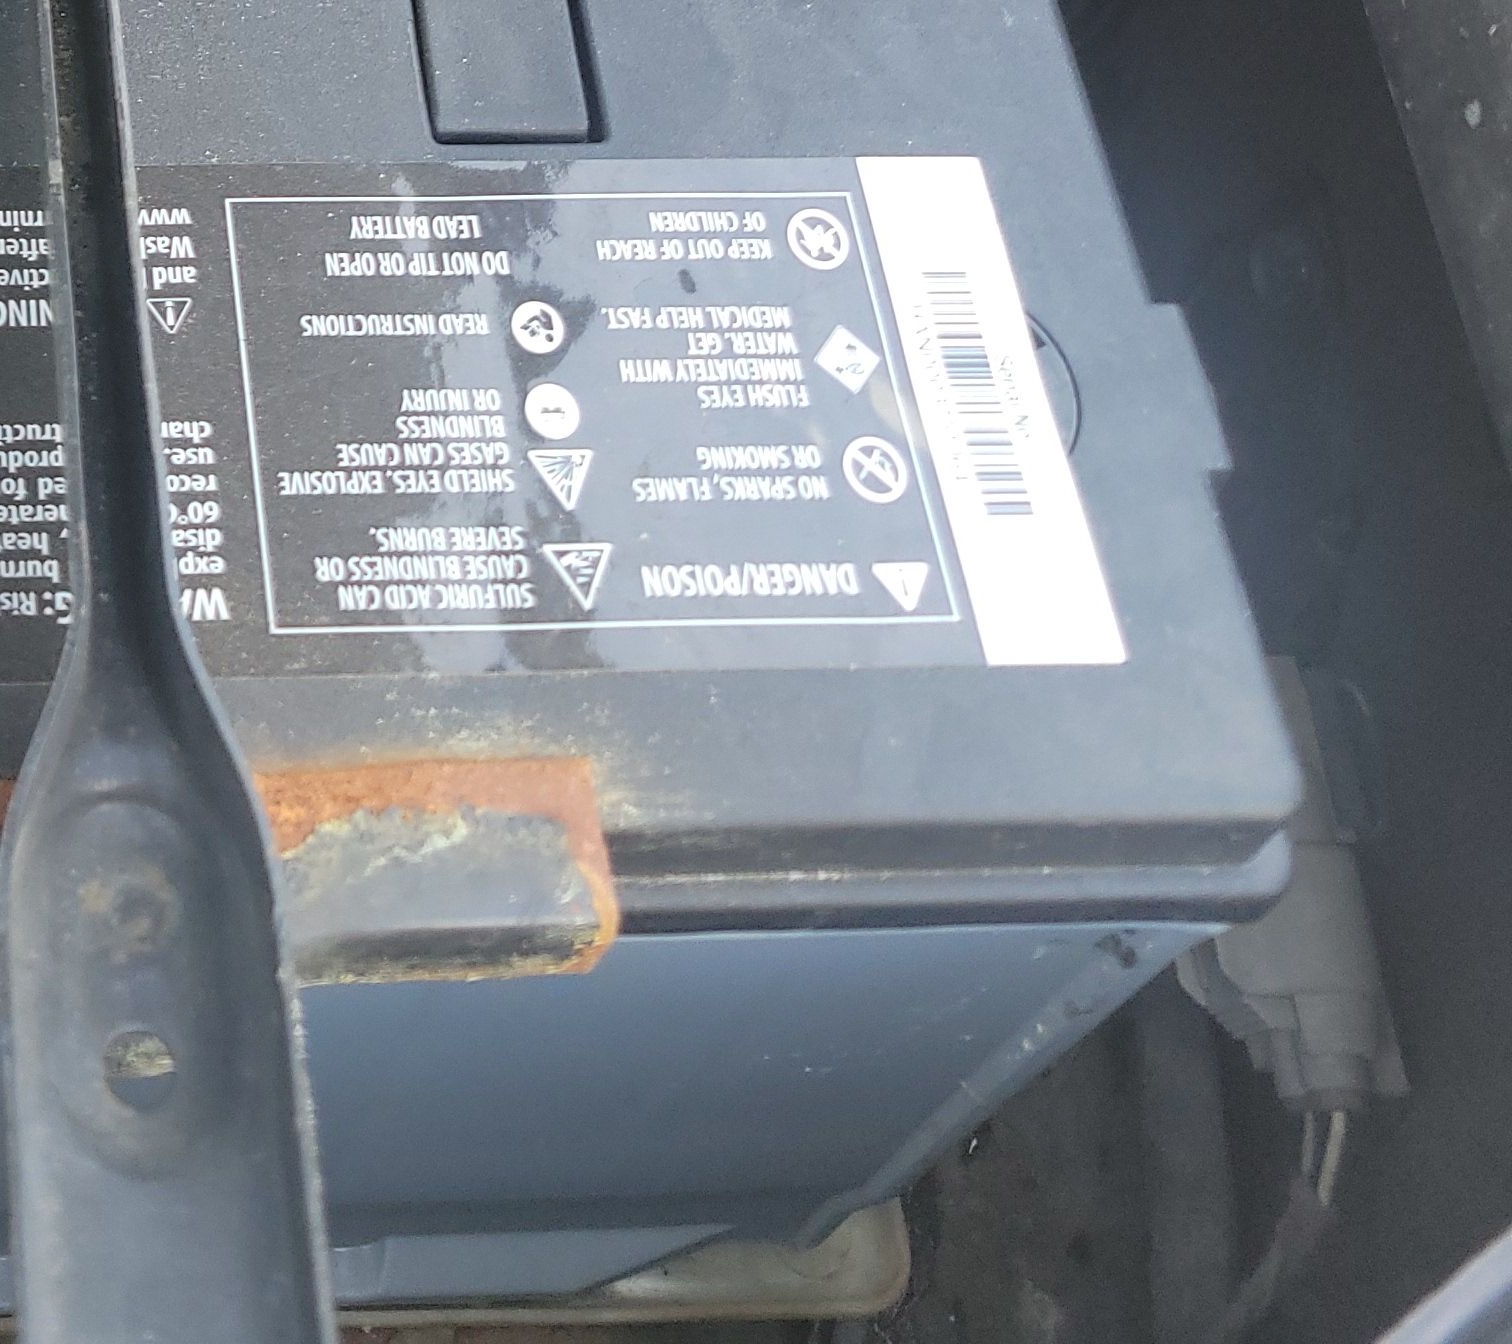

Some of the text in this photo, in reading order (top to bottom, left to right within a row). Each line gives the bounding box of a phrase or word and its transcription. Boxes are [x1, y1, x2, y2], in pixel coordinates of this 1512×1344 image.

[349, 215, 481, 239] LEAD BATTERY
[648, 210, 766, 233] OF CHILDREN
[596, 238, 773, 261] KEEP OUT OF REACH
[324, 251, 509, 276] DO NOT TIP OR OPEN
[152, 265, 197, 290] and
[299, 313, 489, 336] READ INSTRUCTIONS
[600, 306, 791, 329] MEDICAL HELP FAST.
[687, 332, 797, 355] WATER. GET
[619, 358, 804, 382] IMMEDIATELY WITH
[400, 389, 500, 412] OR INJURY
[697, 385, 810, 408] FLUSH EYES
[395, 415, 505, 439] BLINDNESS
[163, 447, 215, 465] use.
[335, 442, 510, 467] GASES CAN CAUSE
[696, 445, 821, 470] OR SMOKING
[277, 468, 515, 495] SHIELD EYES. EXPLOSIVE
[632, 474, 829, 502] NO SPARKS, FLAMES
[368, 526, 524, 552] SEVERE BURNS.
[314, 554, 528, 581] CAUSE BLINDNESS OR
[641, 562, 859, 597] DANGER/POISON
[337, 583, 536, 611] SULFURIC ACID CAN
